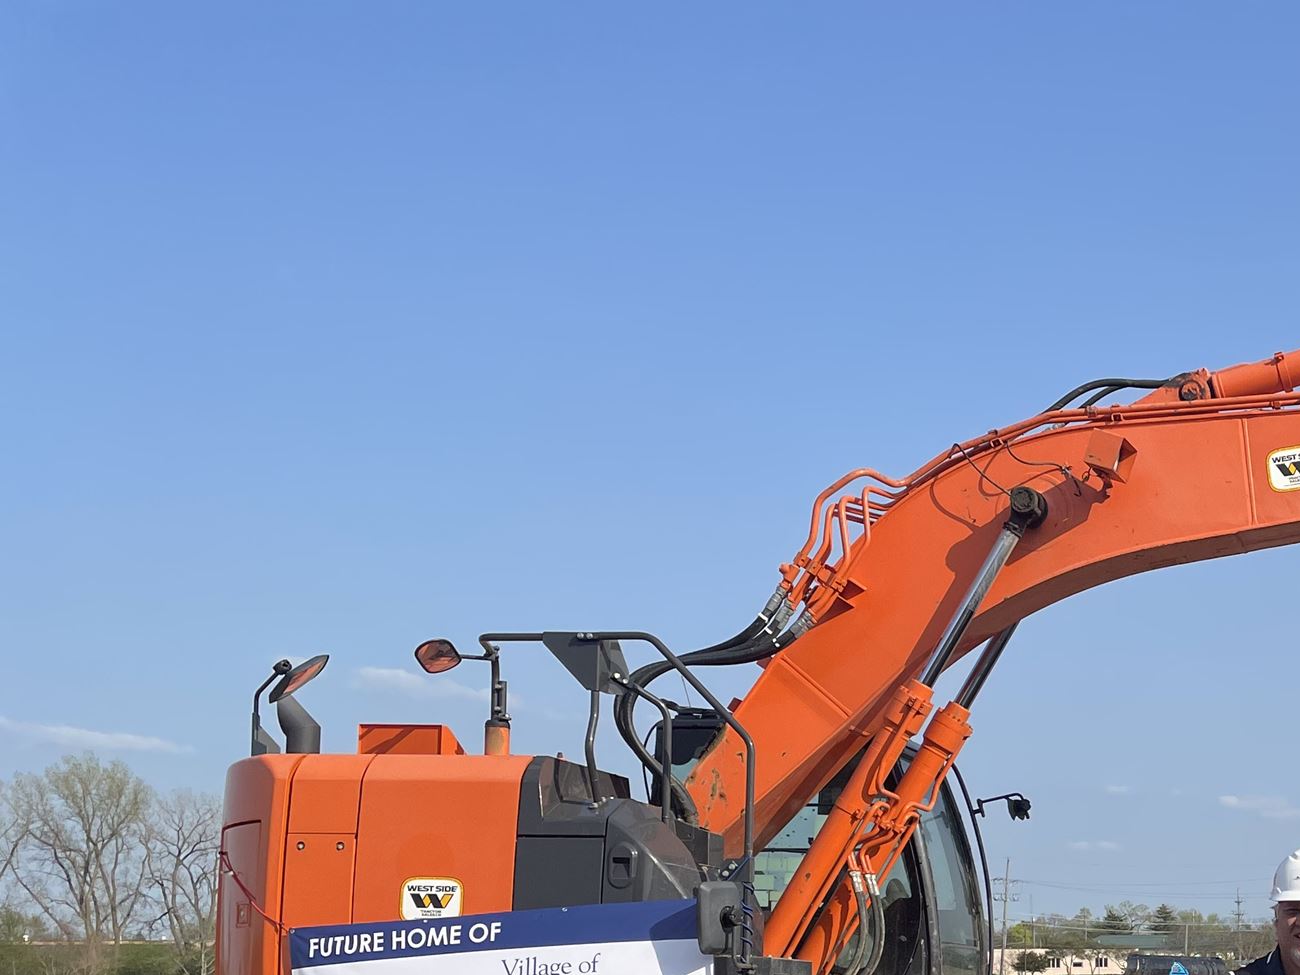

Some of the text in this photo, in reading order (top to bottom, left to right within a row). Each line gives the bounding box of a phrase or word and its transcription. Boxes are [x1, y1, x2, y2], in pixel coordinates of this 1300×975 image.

[1271, 454, 1297, 463] WEST
[308, 921, 502, 959] FUTURE HOME OF
[578, 952, 601, 974] of
